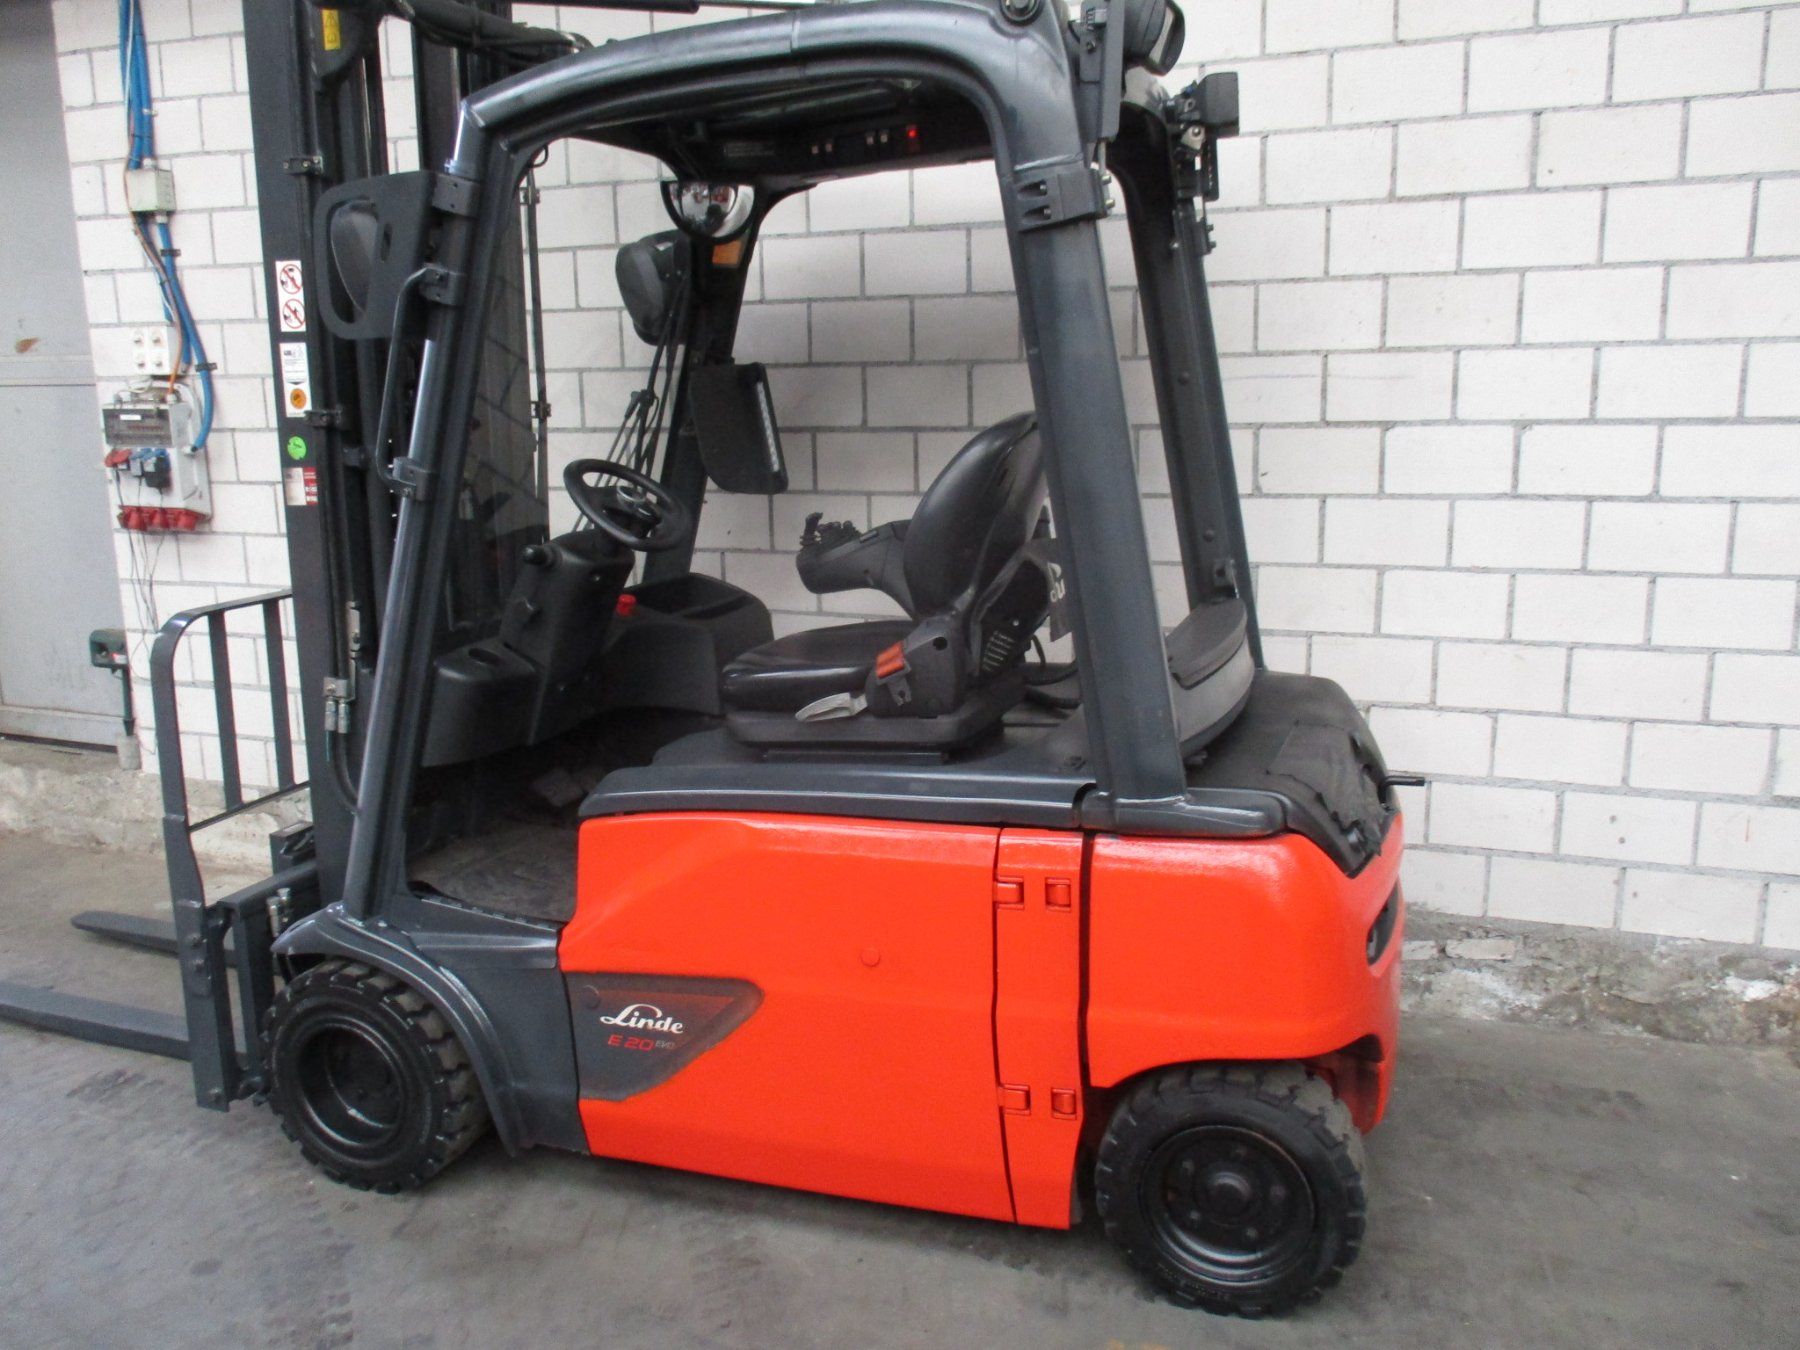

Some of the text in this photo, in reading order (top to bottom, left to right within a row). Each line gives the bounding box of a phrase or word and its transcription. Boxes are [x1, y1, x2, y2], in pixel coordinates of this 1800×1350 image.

[600, 1003, 684, 1034] Linde
[608, 1034, 623, 1047] E
[624, 1036, 654, 1051] 20
